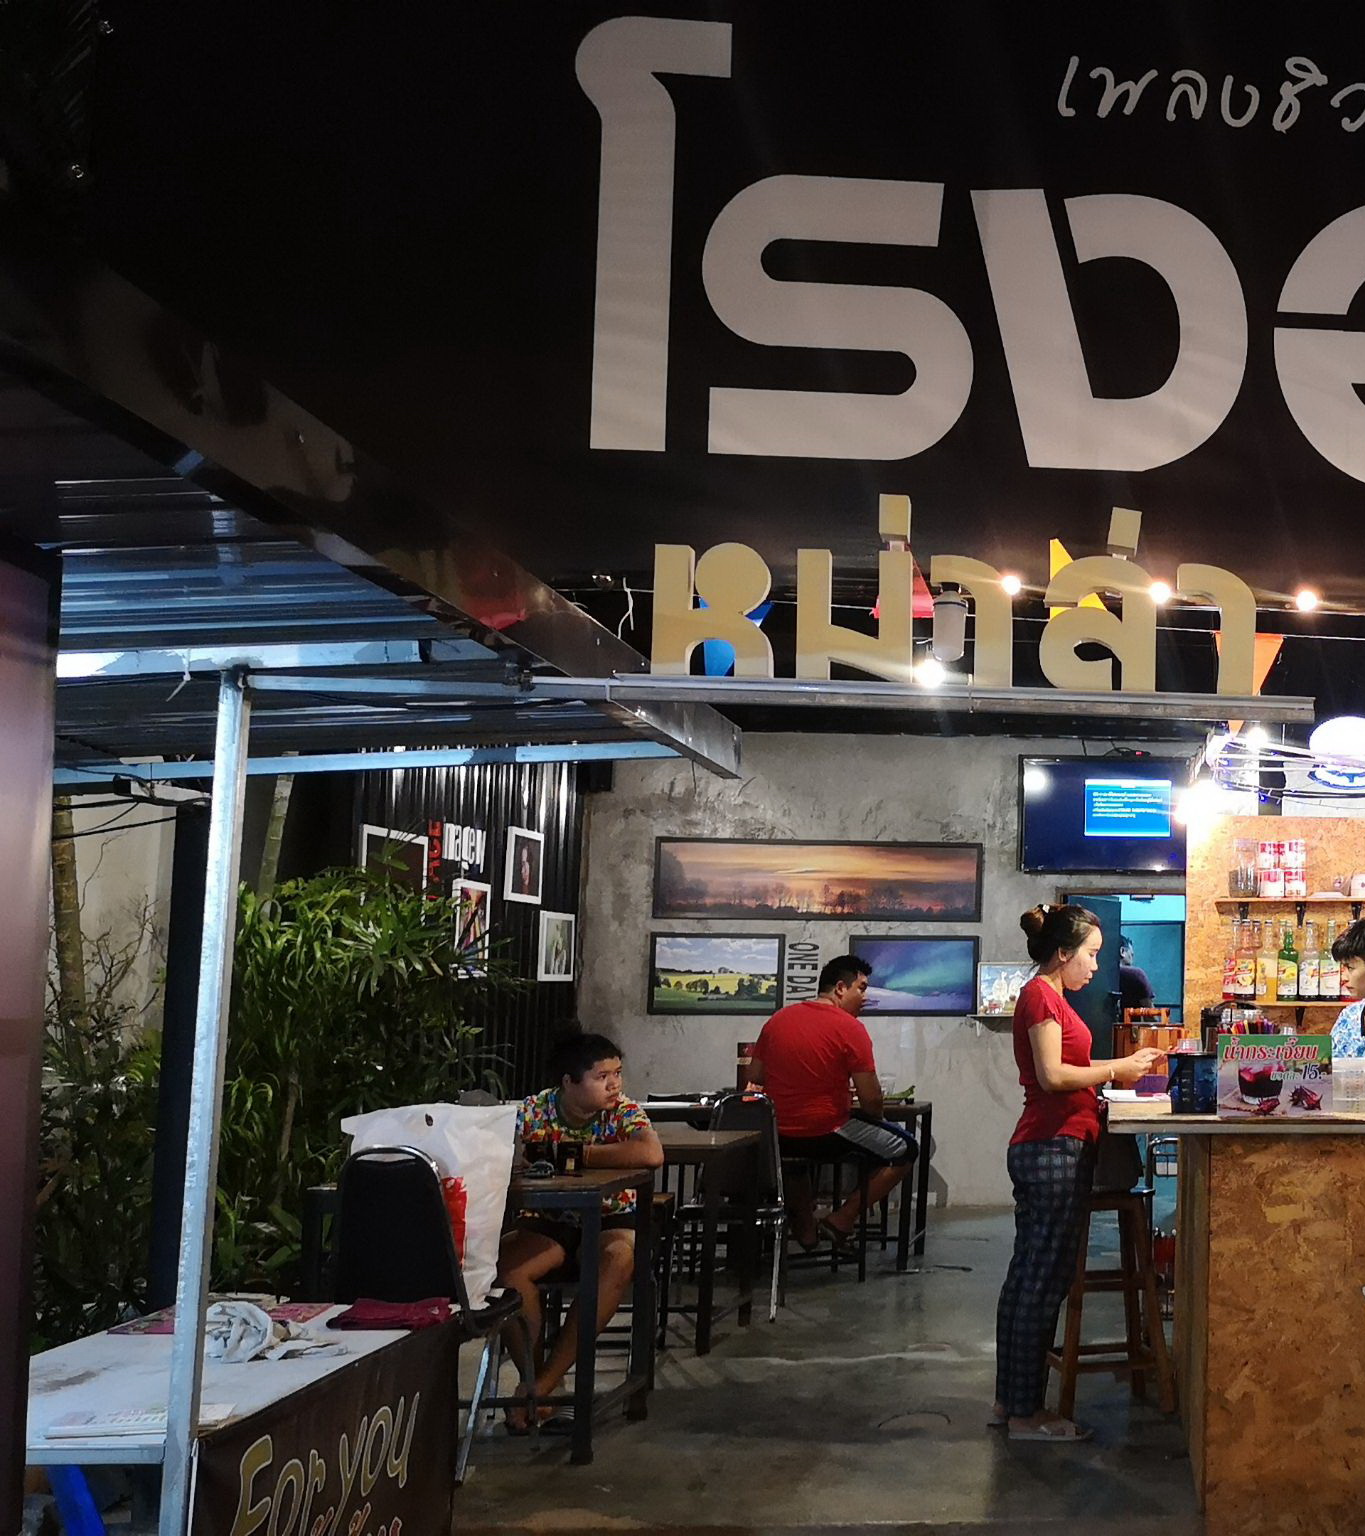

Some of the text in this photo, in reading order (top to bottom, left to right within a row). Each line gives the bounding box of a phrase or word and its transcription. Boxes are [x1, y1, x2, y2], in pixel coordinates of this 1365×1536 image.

[651, 494, 1257, 696] หม่าล่า
[788, 942, 820, 971] ONE
[230, 1433, 327, 1536] For
